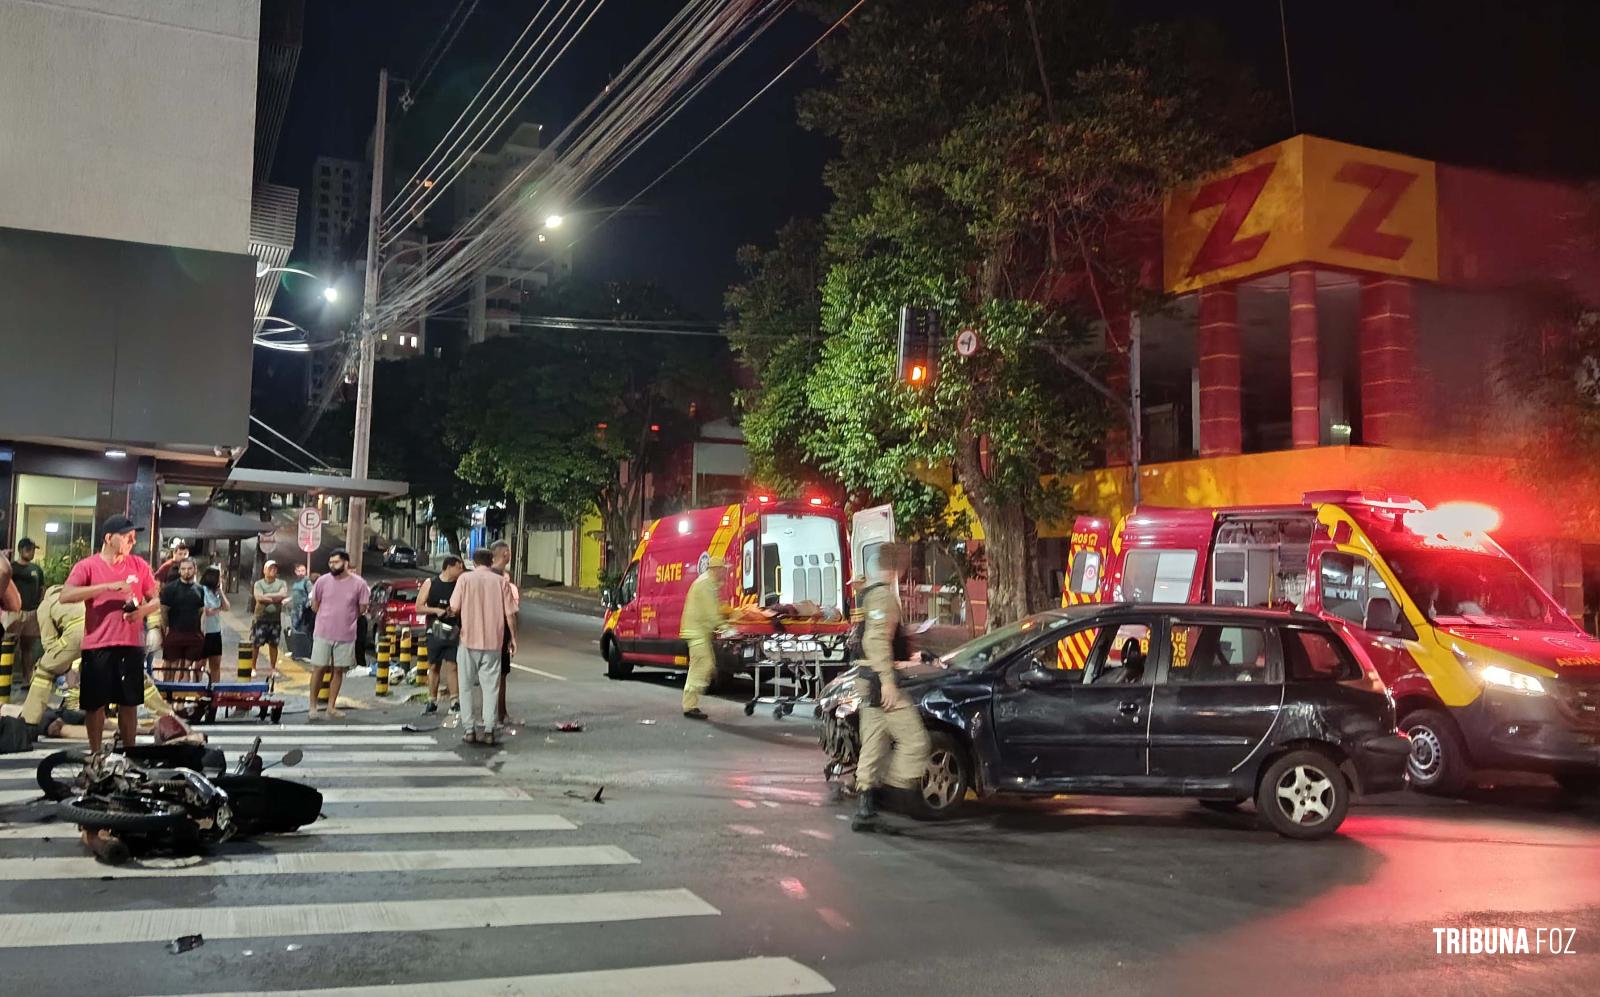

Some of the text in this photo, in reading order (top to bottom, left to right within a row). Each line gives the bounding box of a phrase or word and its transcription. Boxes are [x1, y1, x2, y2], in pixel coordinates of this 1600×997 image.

[1186, 162, 1277, 277] Z
[1328, 161, 1420, 261] Z
[306, 512, 315, 526] E
[655, 562, 683, 583] SIATE
